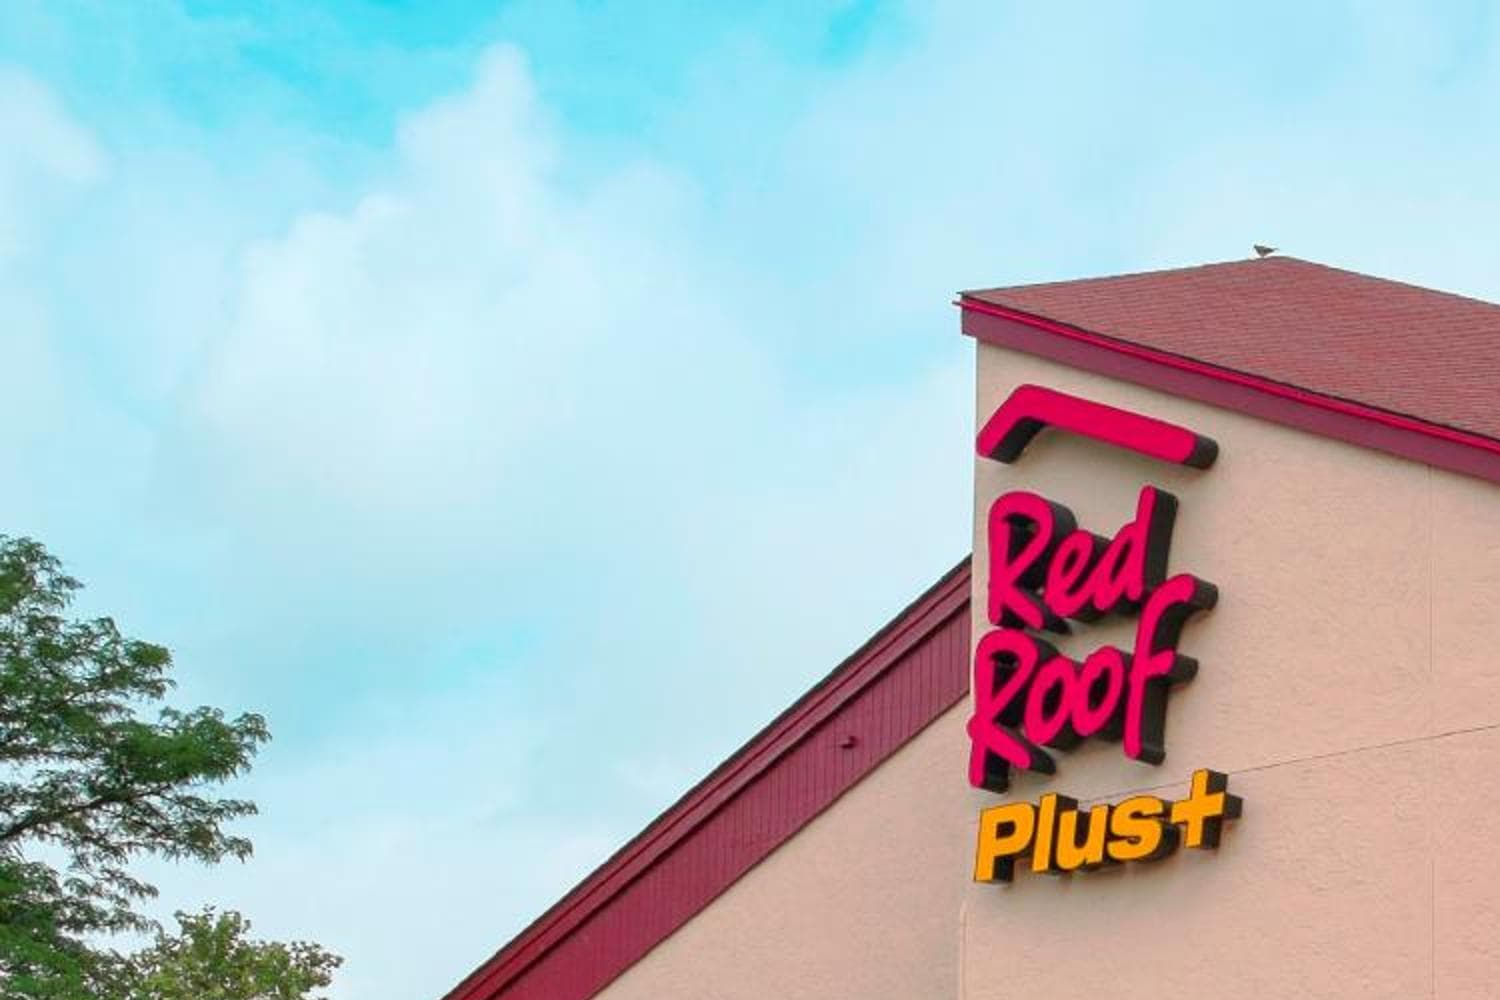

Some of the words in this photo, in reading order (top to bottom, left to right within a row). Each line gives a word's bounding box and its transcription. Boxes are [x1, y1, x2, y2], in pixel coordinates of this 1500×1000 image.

[987, 484, 1157, 630] Red
[966, 572, 1197, 788] Roof
[973, 768, 1226, 883] Plus+
